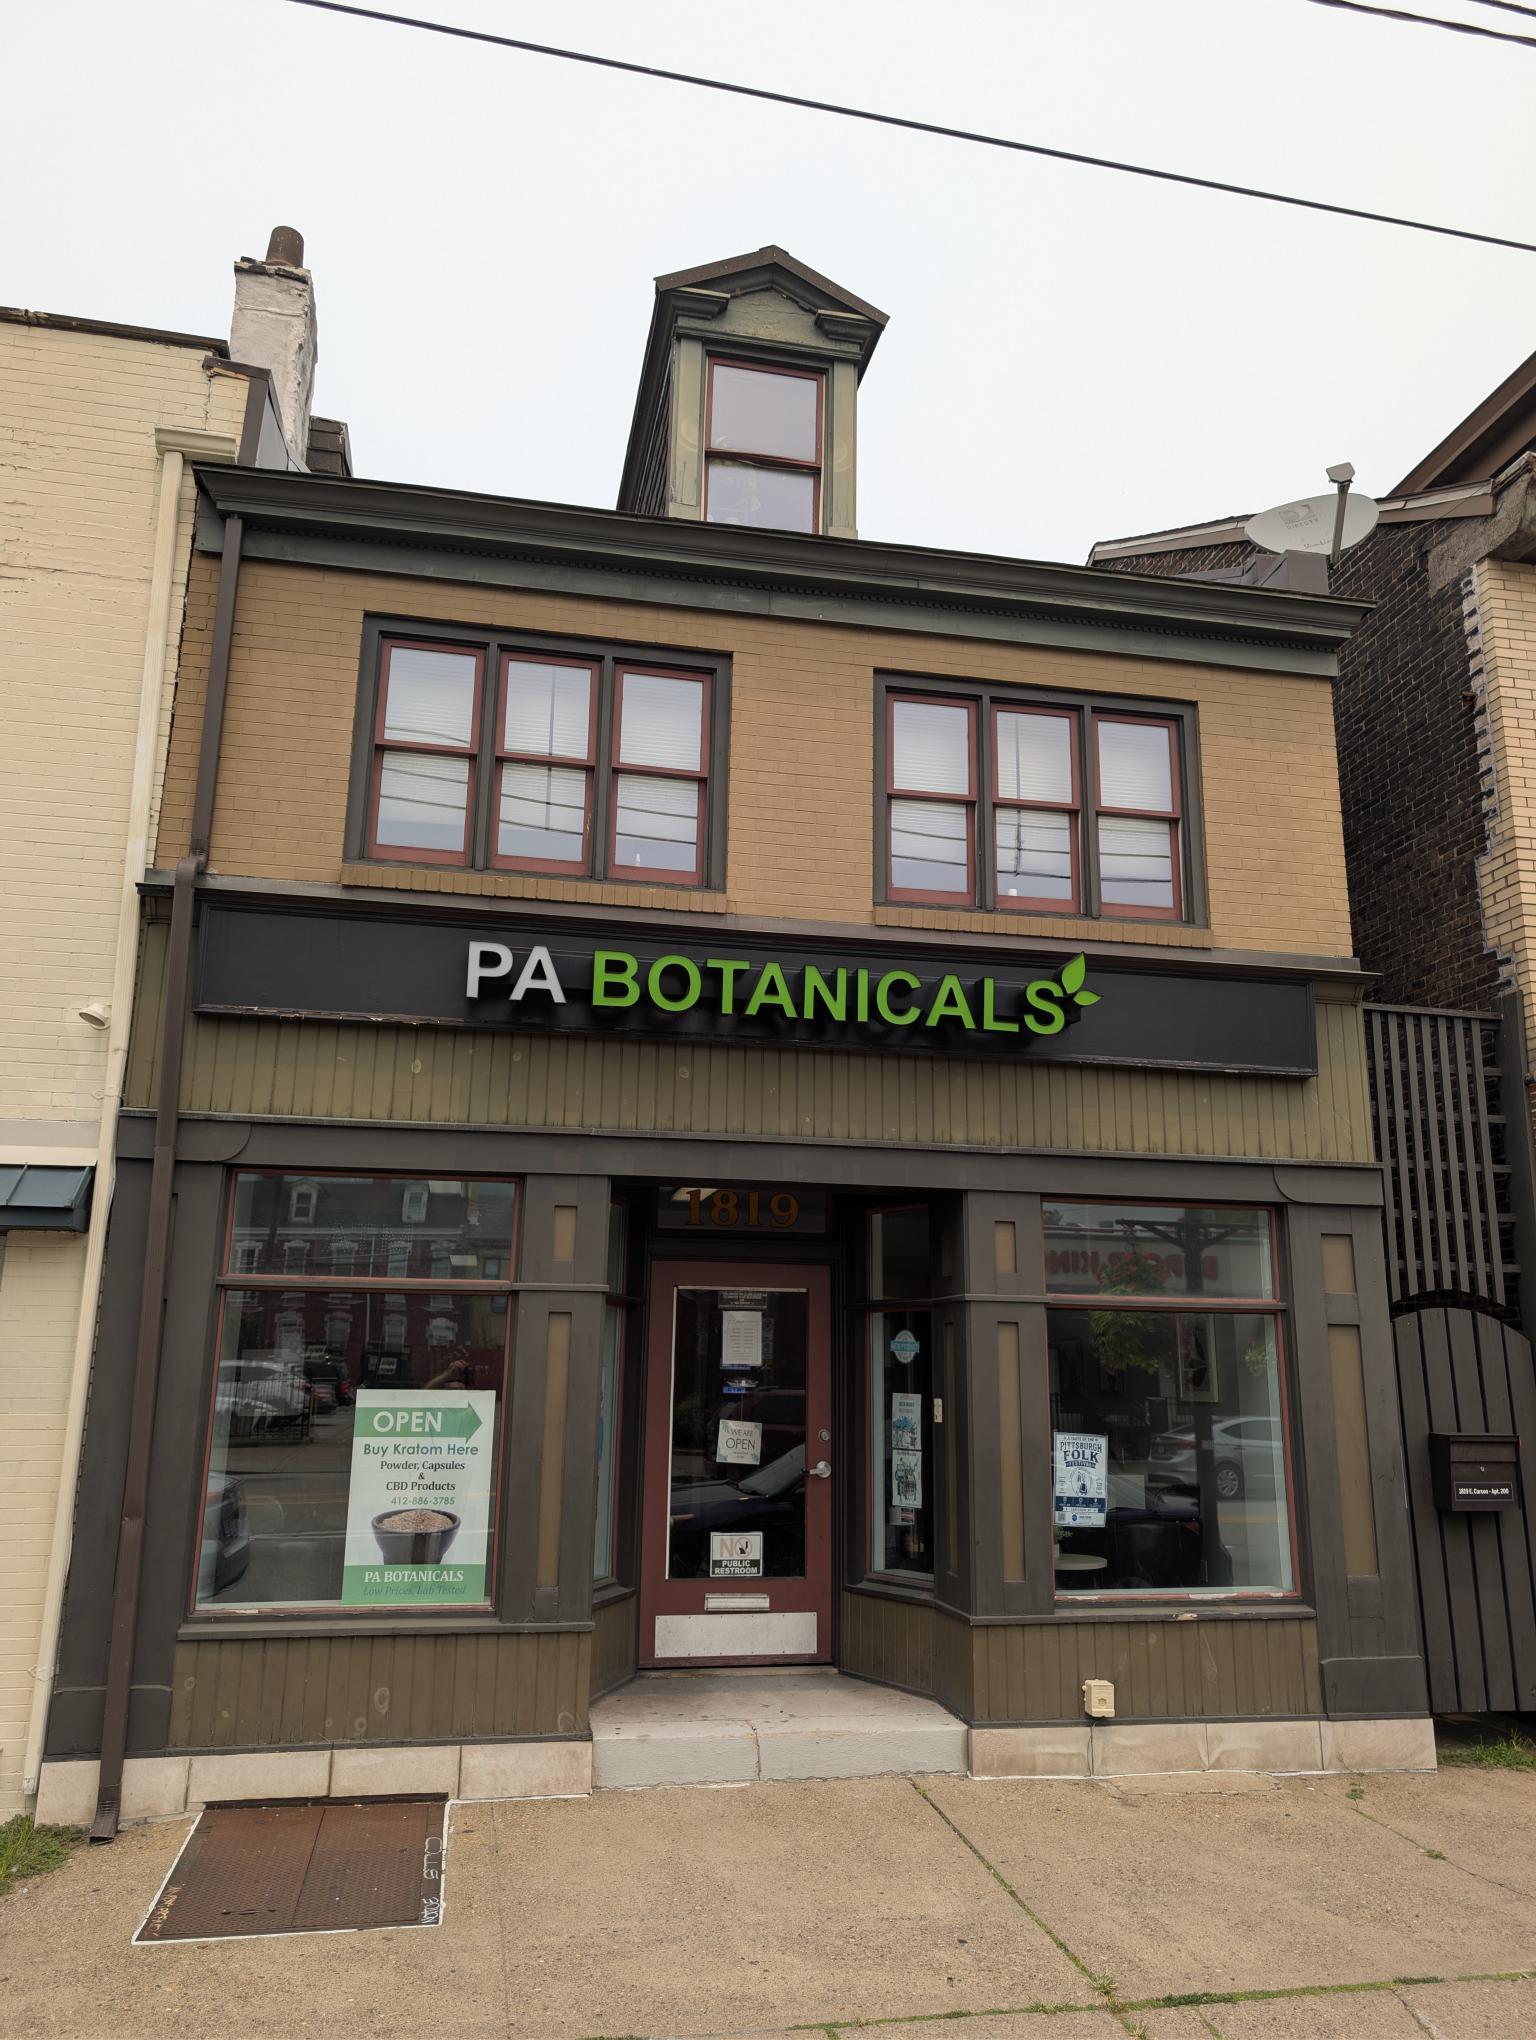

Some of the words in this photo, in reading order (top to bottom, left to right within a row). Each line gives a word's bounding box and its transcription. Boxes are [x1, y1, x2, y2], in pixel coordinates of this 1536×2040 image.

[465, 940, 567, 1005] PA
[591, 948, 1067, 1036] BOTANICALS
[685, 1188, 800, 1229] 1819
[373, 1411, 442, 1433] OPEN
[725, 1437, 755, 1450] OPEN
[1060, 1441, 1102, 1453] PITTSBURGH
[363, 1443, 389, 1457] Buy
[393, 1443, 442, 1456] Kratom
[447, 1443, 479, 1456] Here
[1063, 1449, 1099, 1463] FOLK
[380, 1460, 420, 1471] Powder,
[422, 1460, 465, 1472] Capsules
[418, 1472, 425, 1480] &
[386, 1482, 408, 1491] CBD
[411, 1481, 456, 1491] Products
[390, 1496, 456, 1506] 412-886-3785
[722, 1559, 751, 1568] PUBLIC
[364, 1571, 381, 1583] PA
[384, 1570, 464, 1582] BOTANICALS
[714, 1567, 758, 1575] RESTROOM
[363, 1586, 384, 1596] Low
[417, 1585, 435, 1595] Lab
[436, 1585, 466, 1595] Tested
